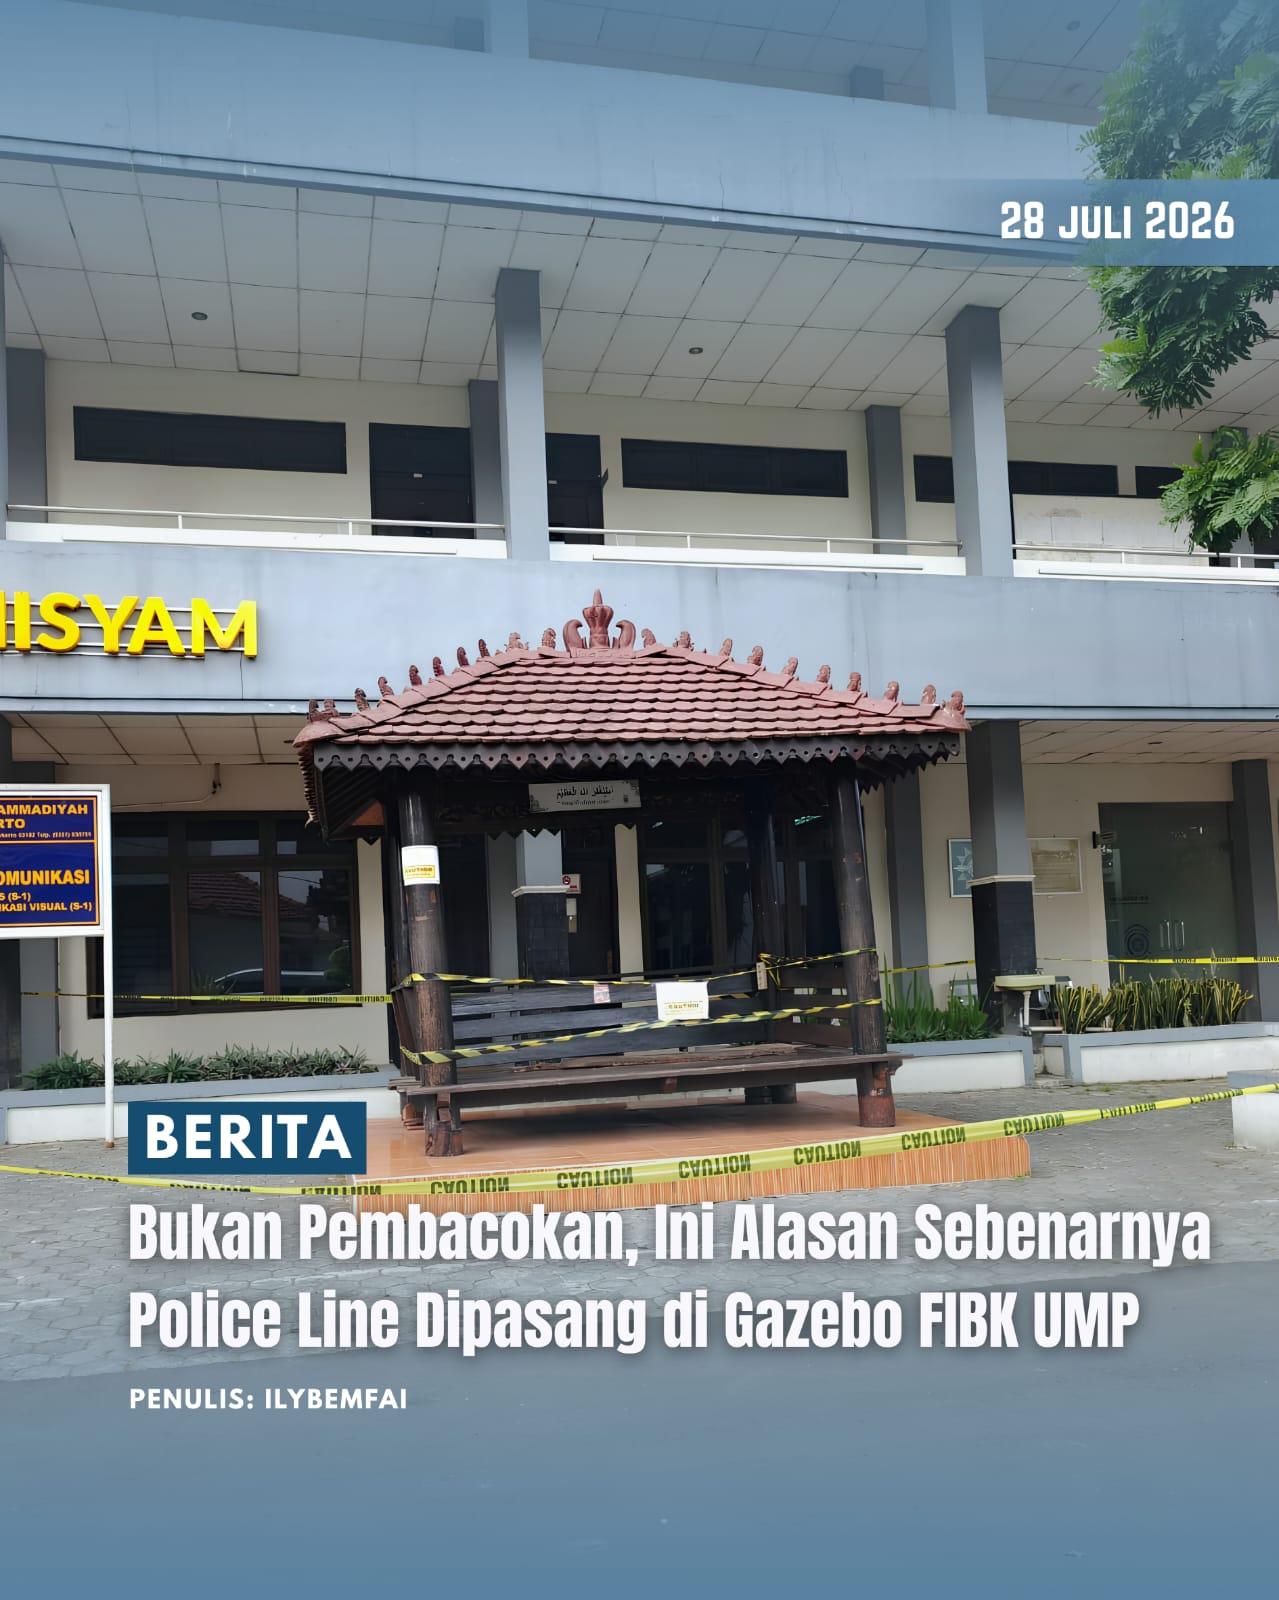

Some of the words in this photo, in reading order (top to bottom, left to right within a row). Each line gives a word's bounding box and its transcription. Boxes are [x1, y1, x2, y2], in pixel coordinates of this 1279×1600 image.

[8, 892, 31, 902] (S-1)
[29, 902, 68, 911] VISUAL
[69, 902, 92, 912] (S-1)
